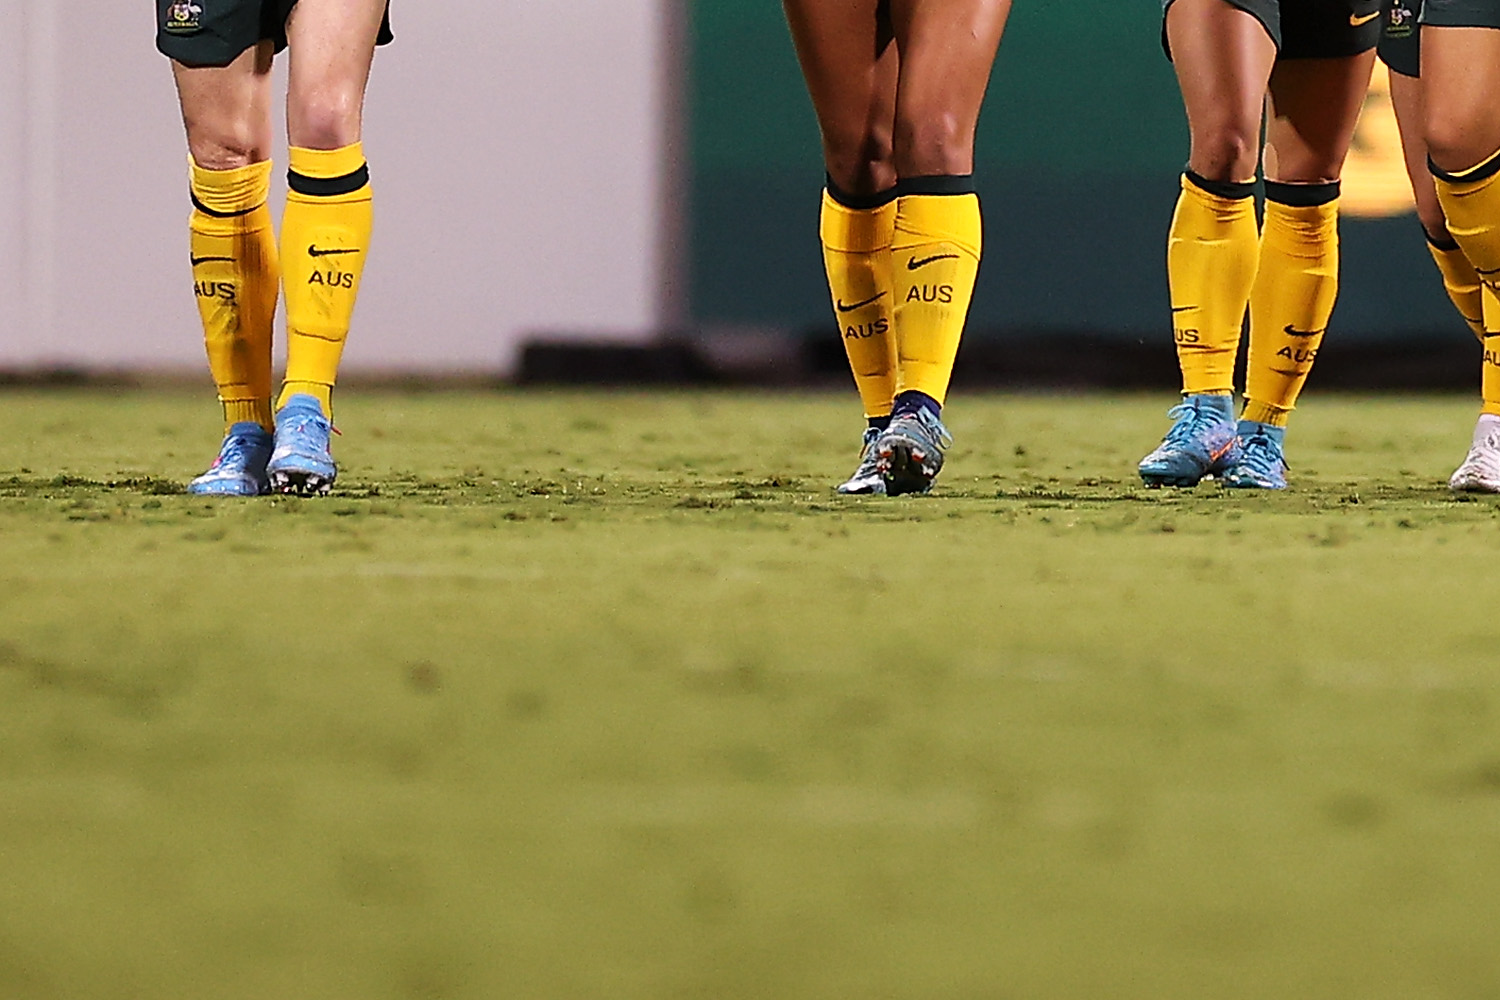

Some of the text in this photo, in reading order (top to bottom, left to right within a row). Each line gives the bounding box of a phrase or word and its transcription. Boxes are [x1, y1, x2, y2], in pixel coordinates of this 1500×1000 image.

[308, 270, 354, 289] AUS
[194, 280, 236, 300] AUS
[906, 285, 953, 303] AUS
[846, 318, 889, 339] AUS
[1176, 329, 1200, 343] US
